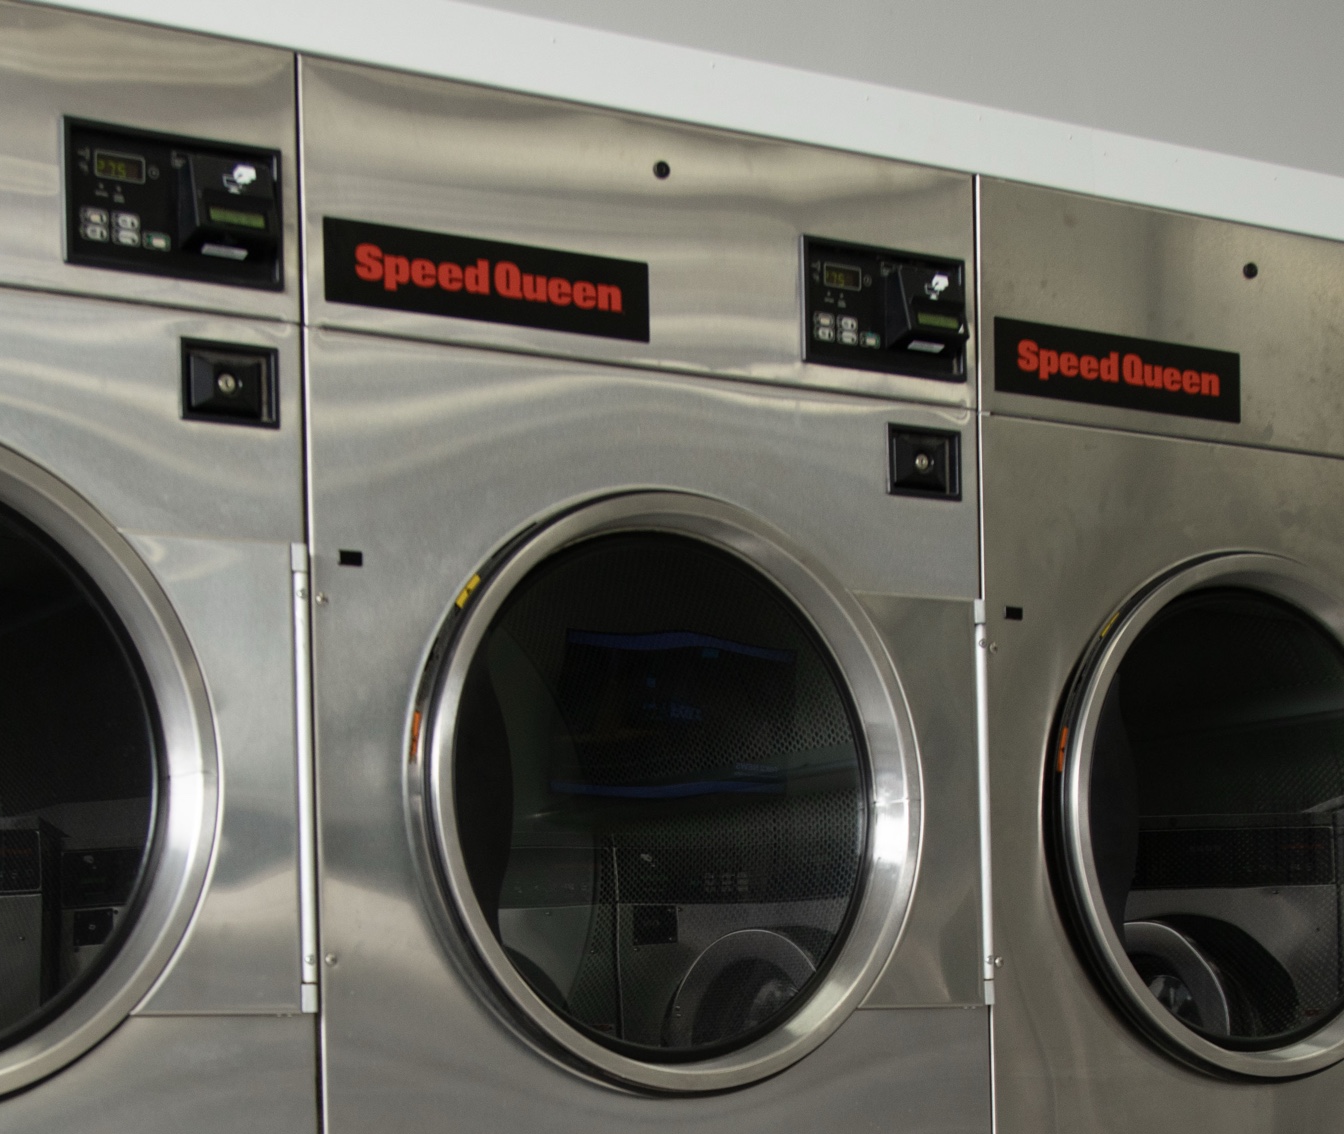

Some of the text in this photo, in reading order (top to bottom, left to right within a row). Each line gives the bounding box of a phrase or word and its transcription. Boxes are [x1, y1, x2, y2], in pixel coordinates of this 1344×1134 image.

[354, 242, 623, 313] Speed Queen
[1017, 339, 1221, 396] Speed Queen
